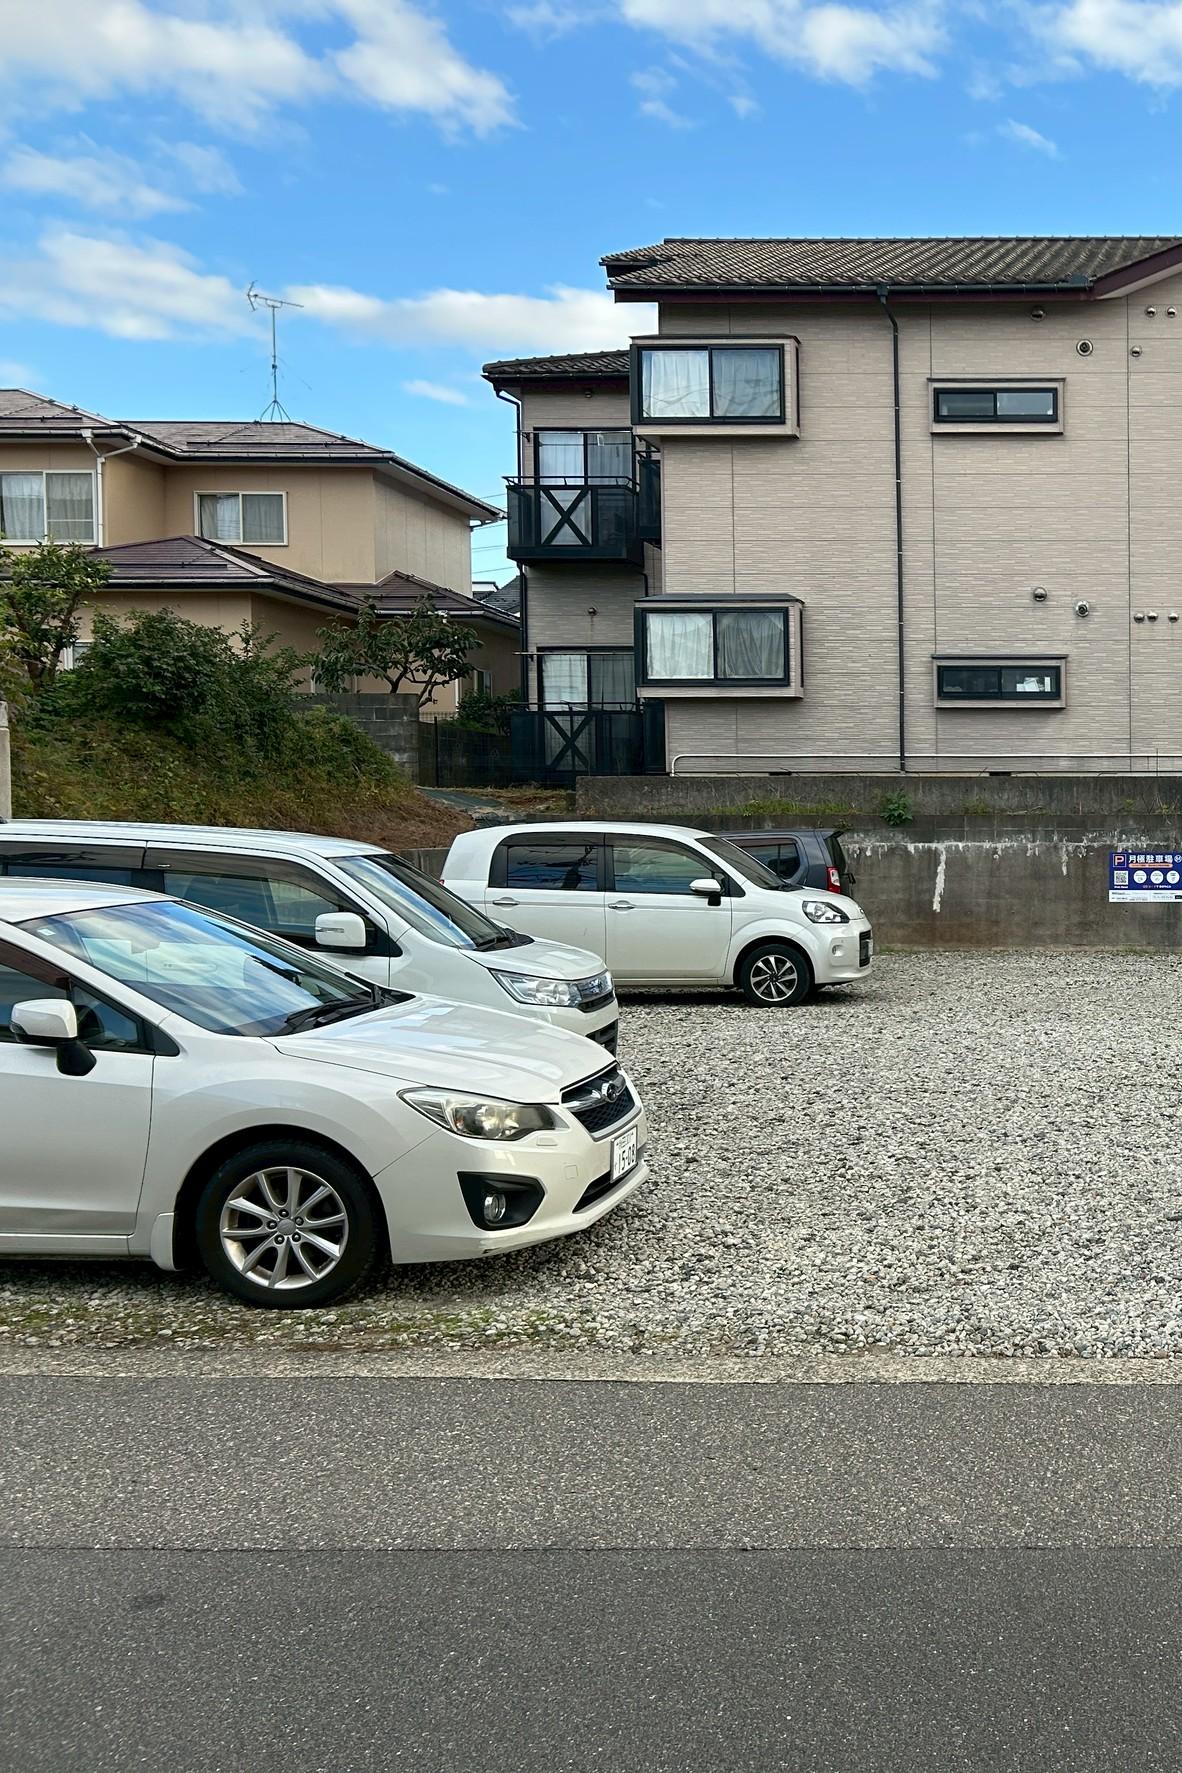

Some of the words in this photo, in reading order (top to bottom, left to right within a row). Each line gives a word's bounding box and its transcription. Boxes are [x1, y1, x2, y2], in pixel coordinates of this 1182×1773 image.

[1115, 855, 1124, 866] P
[1128, 854, 1173, 864] 月極駐車場
